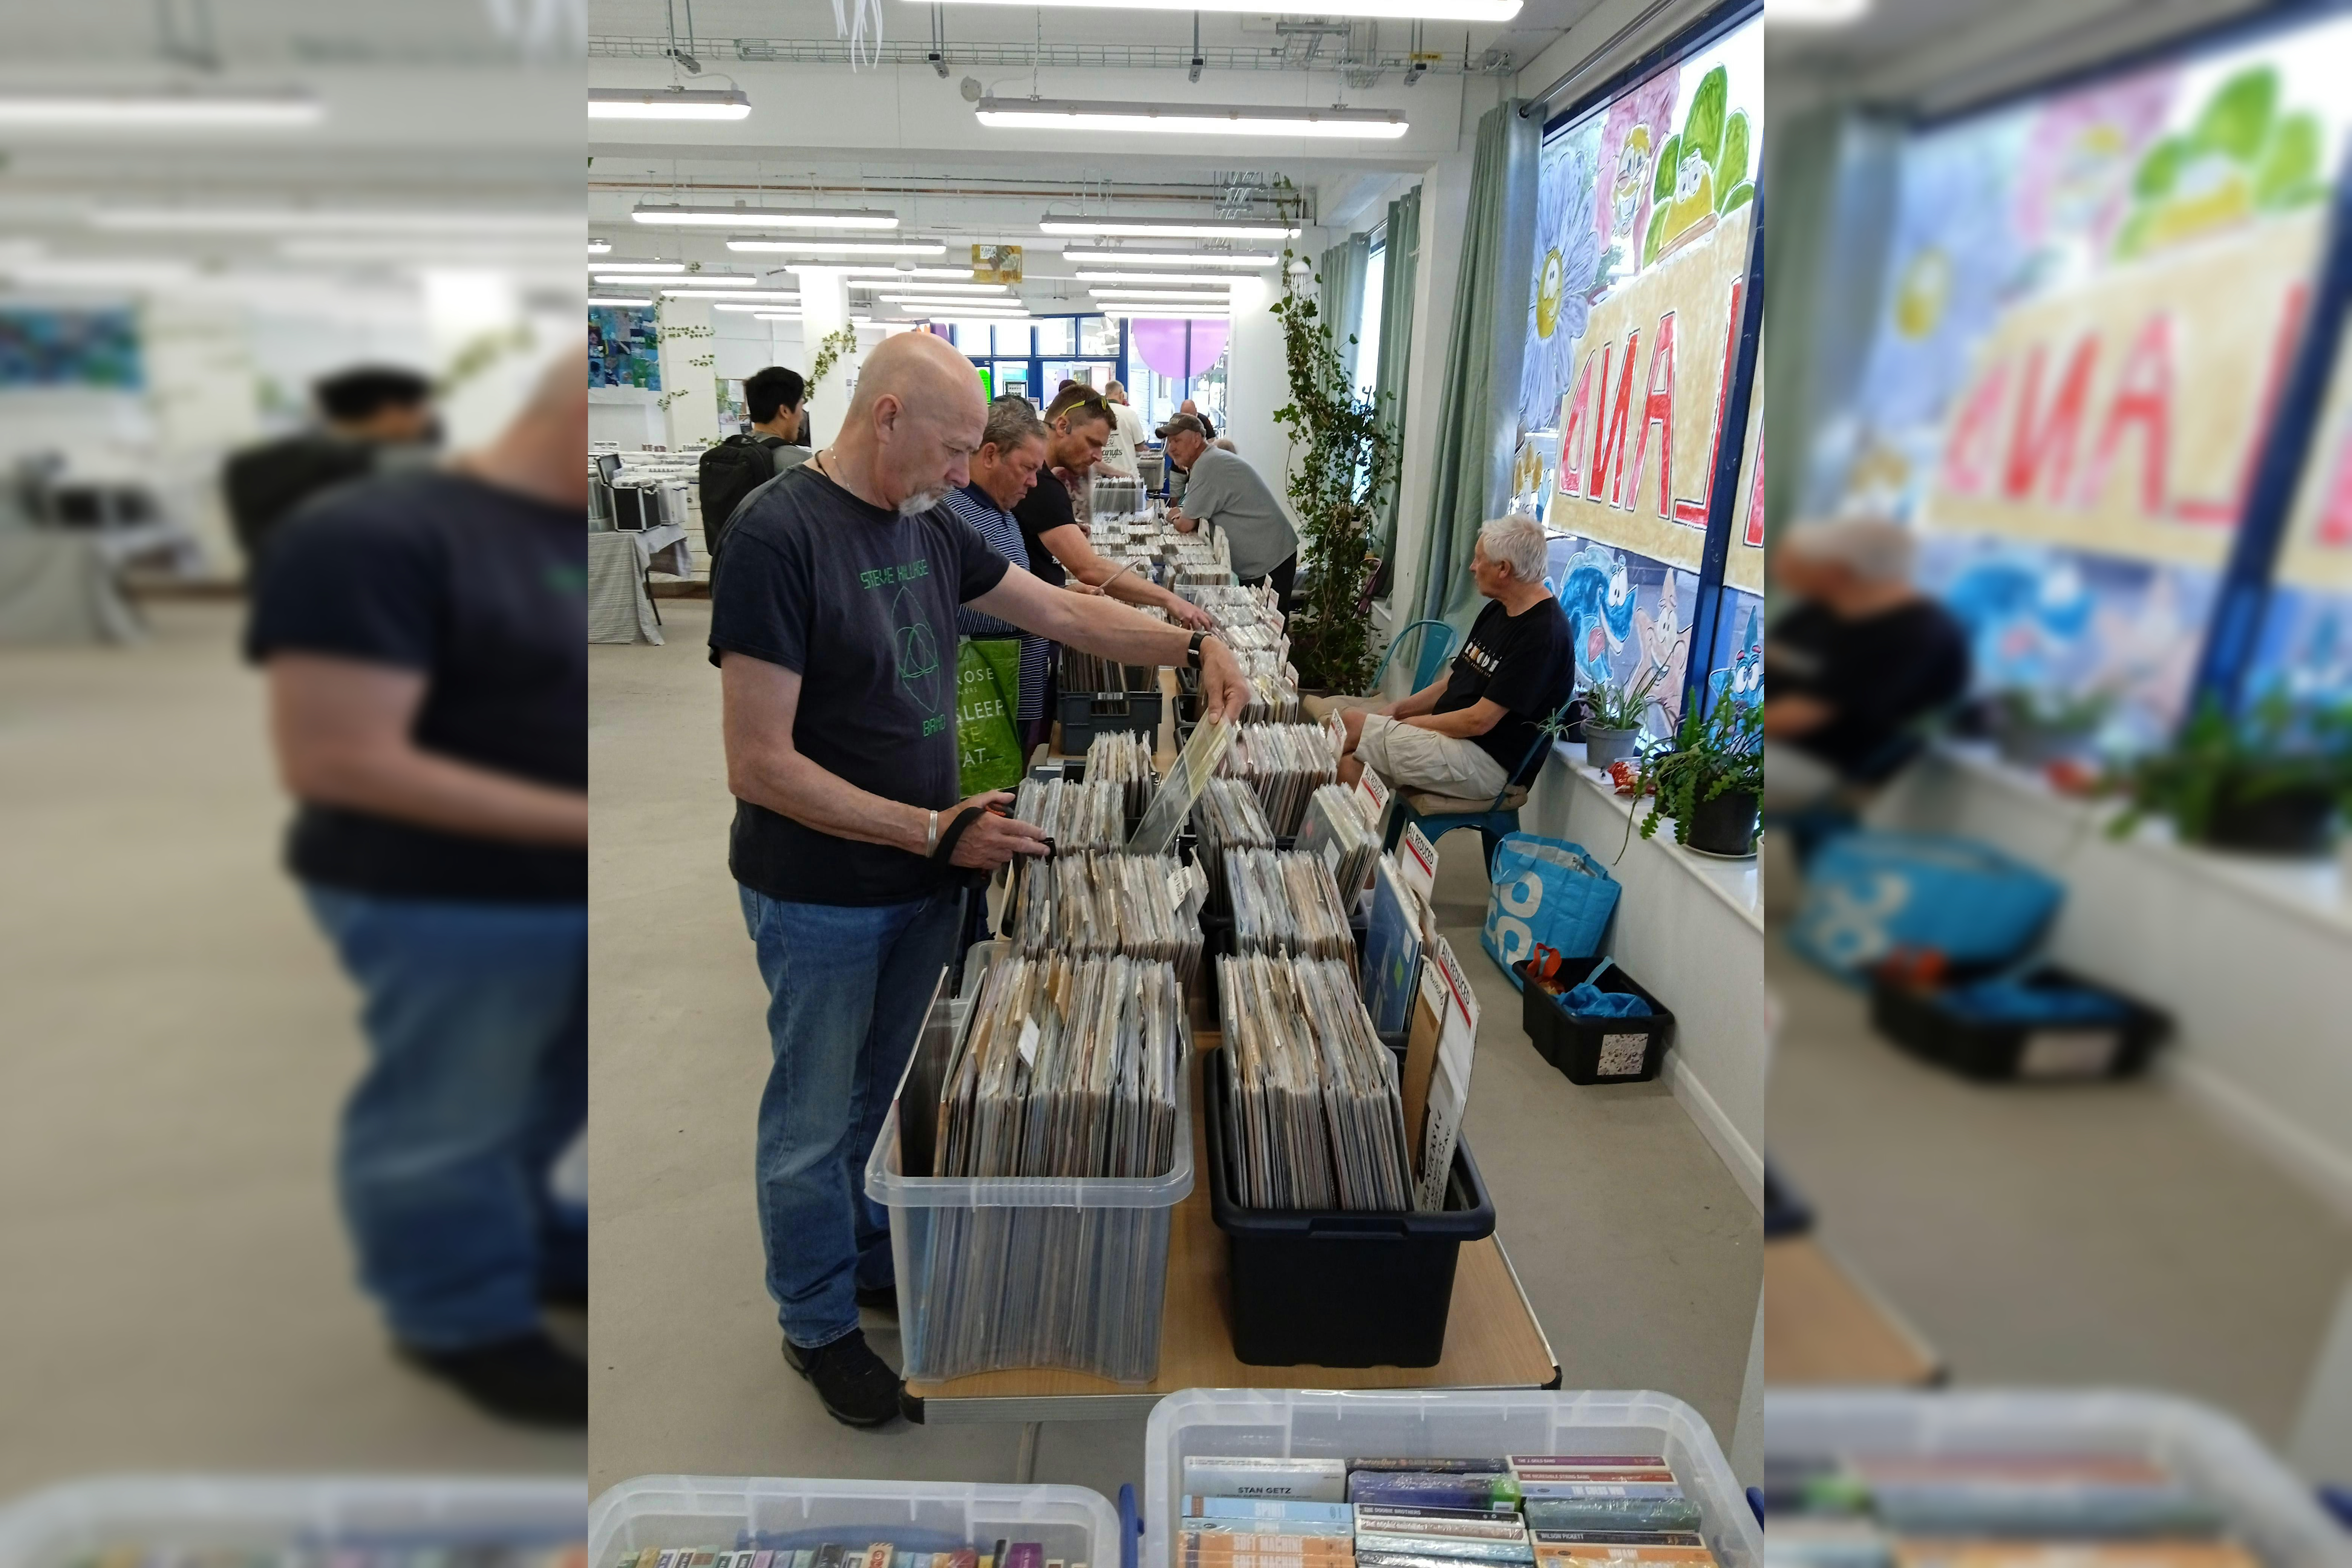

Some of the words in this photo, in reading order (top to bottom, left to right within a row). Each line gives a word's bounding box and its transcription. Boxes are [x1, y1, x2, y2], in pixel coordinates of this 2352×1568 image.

[860, 567, 894, 589] STEVE
[1370, 775, 1384, 799] REDUCED
[1415, 833, 1434, 864] REDUCED
[1441, 944, 1450, 962] ALL
[1449, 958, 1470, 1005] REDUCED
